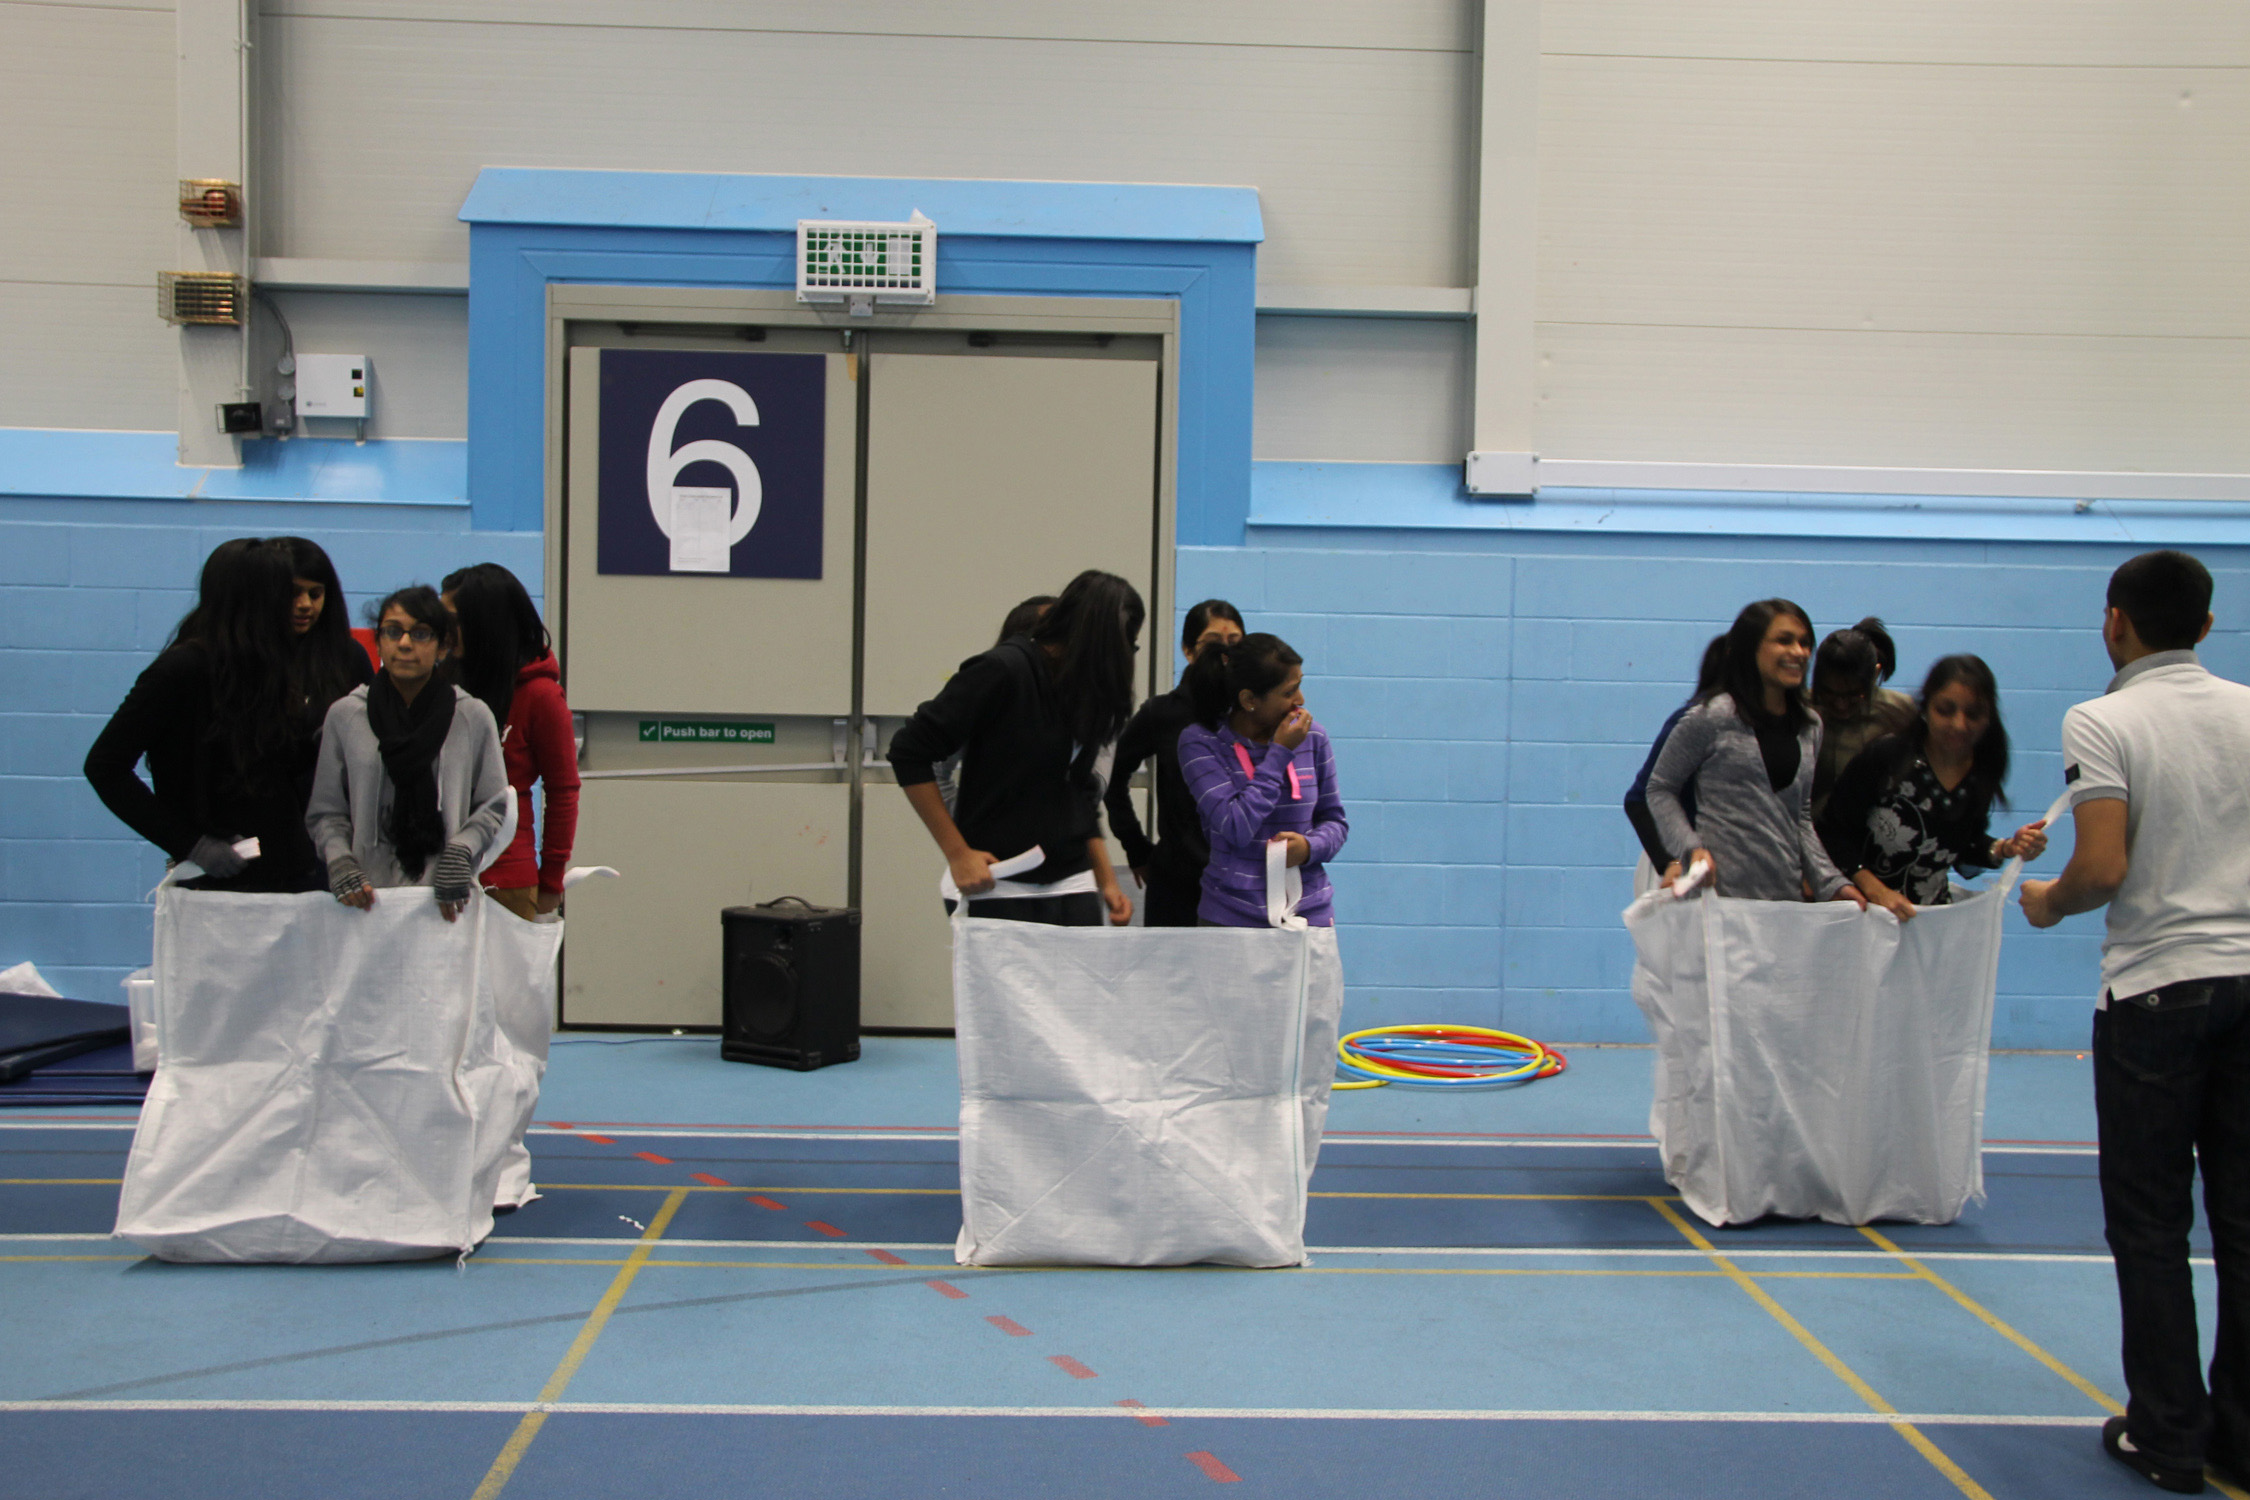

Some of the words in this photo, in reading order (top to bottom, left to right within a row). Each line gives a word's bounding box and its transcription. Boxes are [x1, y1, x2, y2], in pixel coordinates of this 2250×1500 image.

[646, 378, 763, 552] 6
[663, 725, 696, 738] Push
[699, 726, 721, 738] bar
[723, 727, 737, 738] to
[740, 728, 772, 741] open
